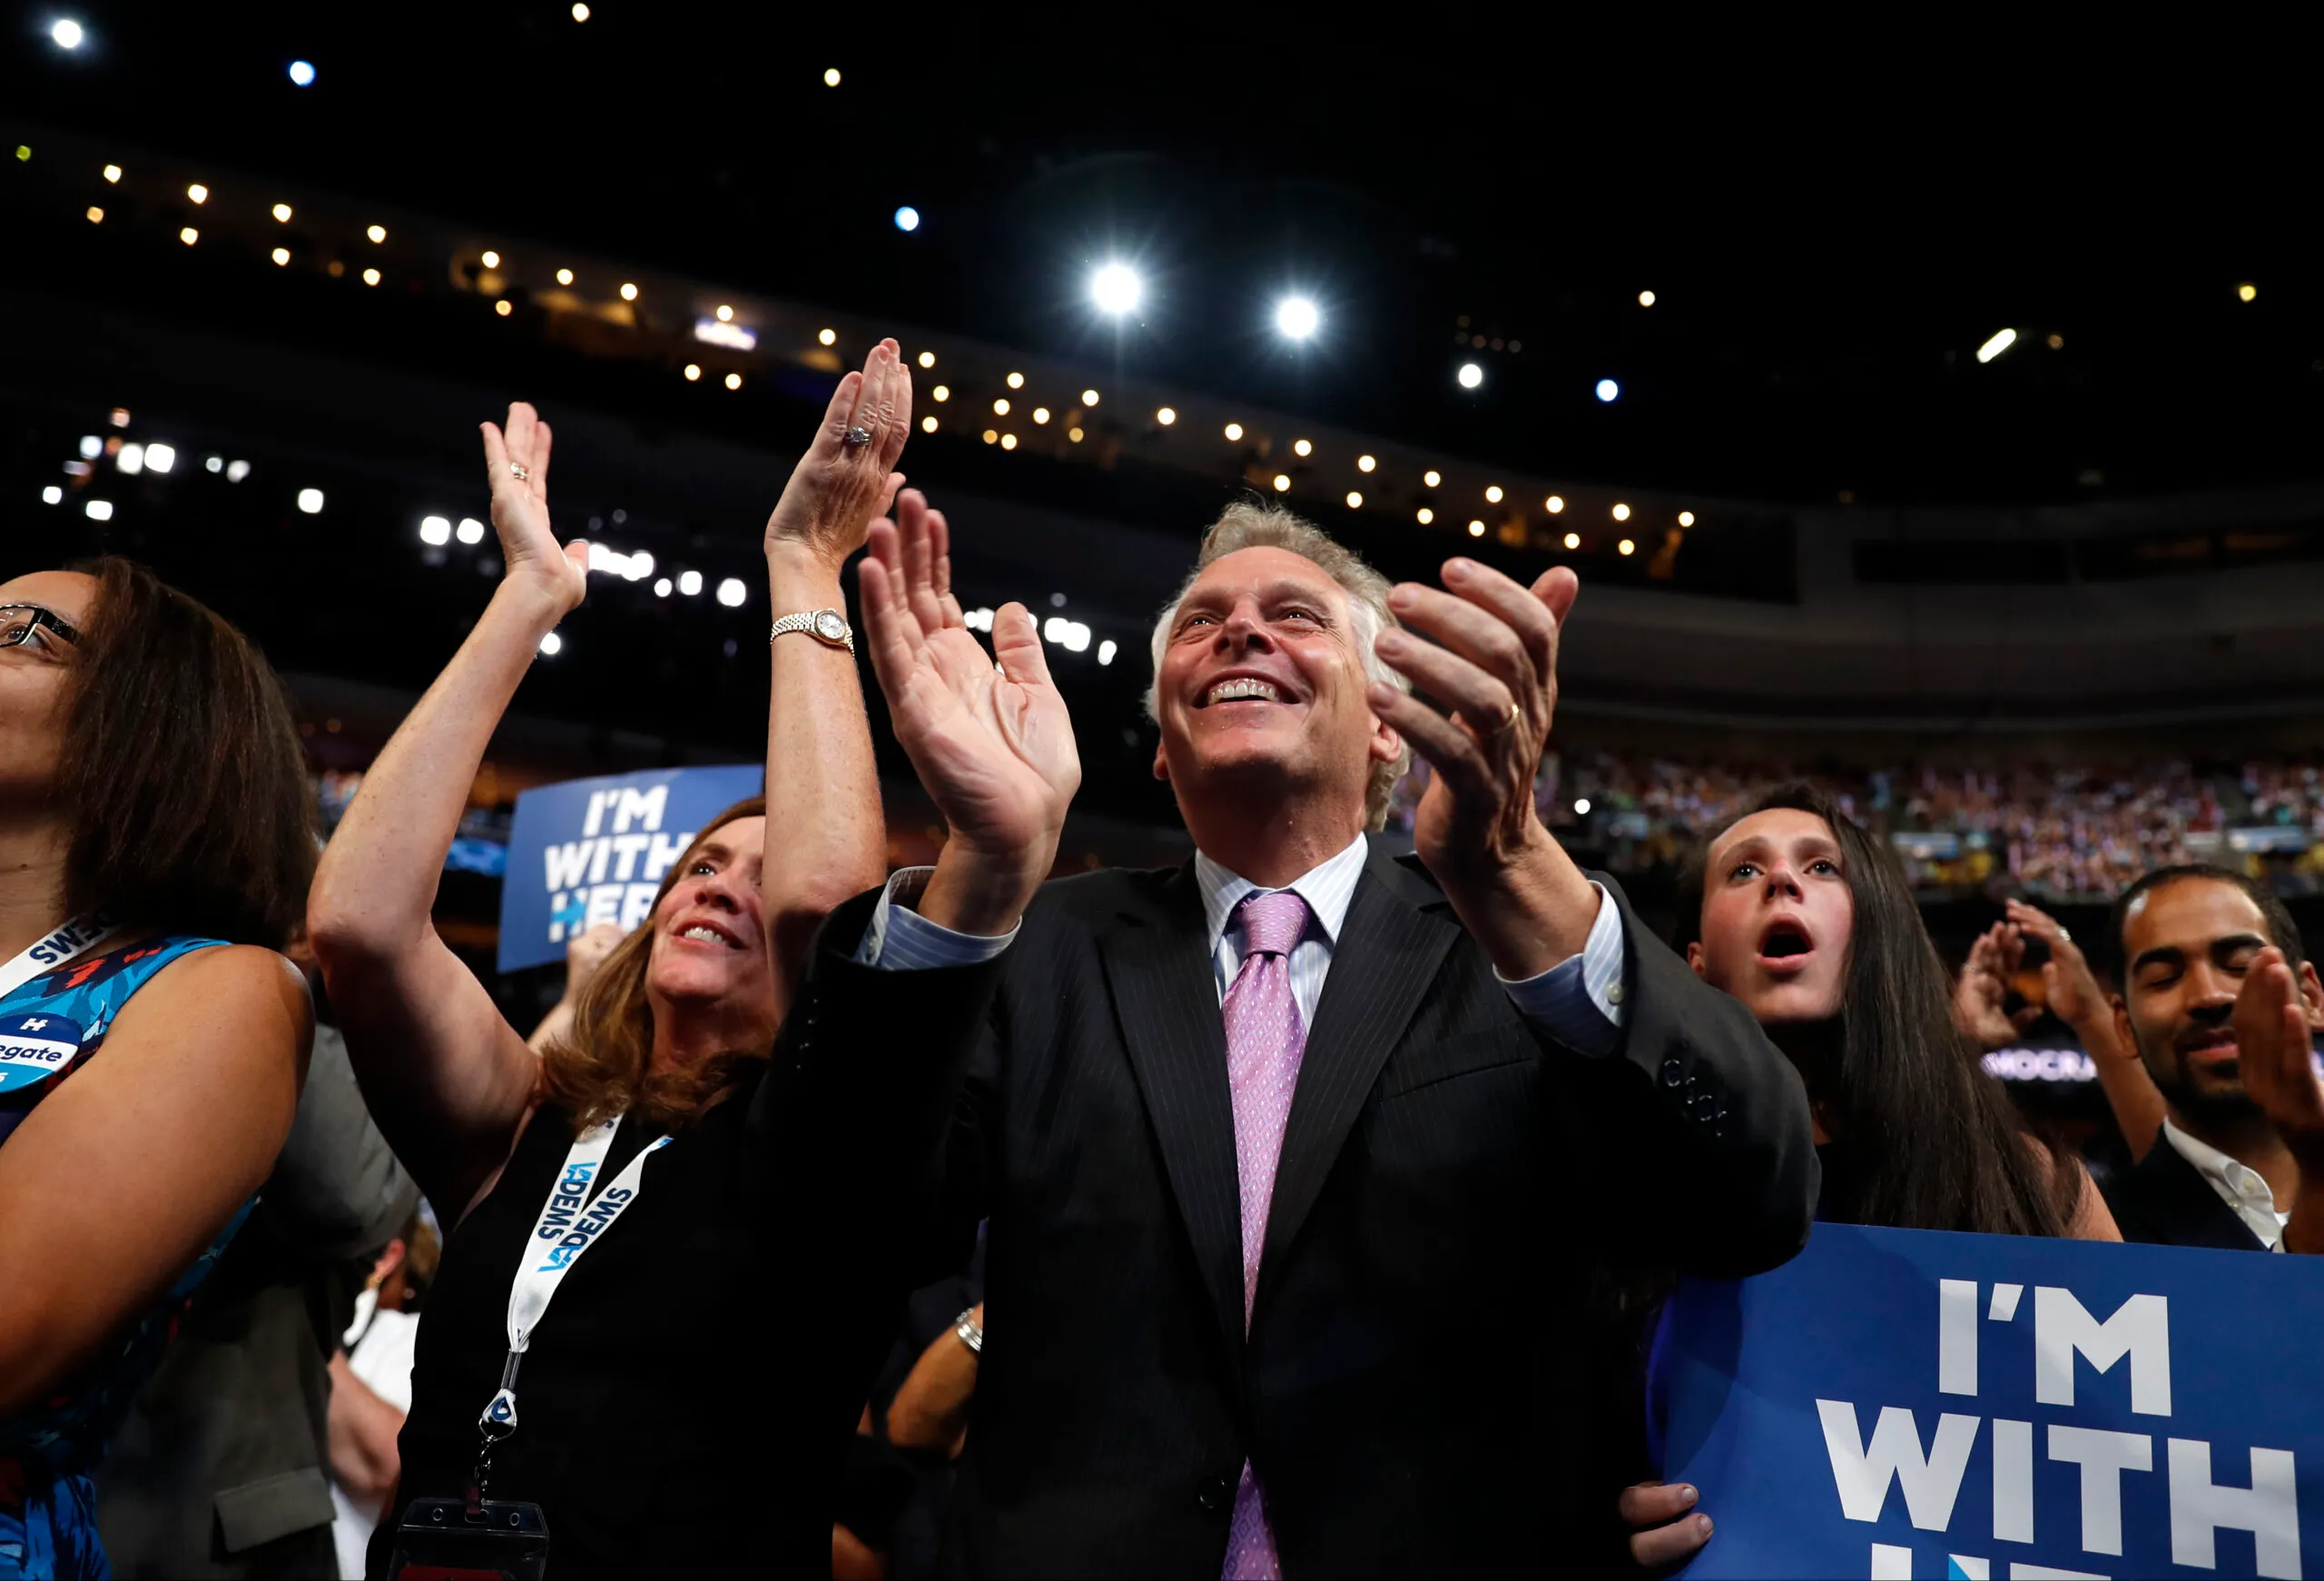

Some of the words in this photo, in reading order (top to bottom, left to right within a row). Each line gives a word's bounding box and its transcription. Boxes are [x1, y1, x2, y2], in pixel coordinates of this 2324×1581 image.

[583, 785, 668, 837] I'M
[545, 832, 697, 893] WITH
[1939, 1279, 2171, 1417] I'M
[1816, 1398, 2302, 1581] WITH
